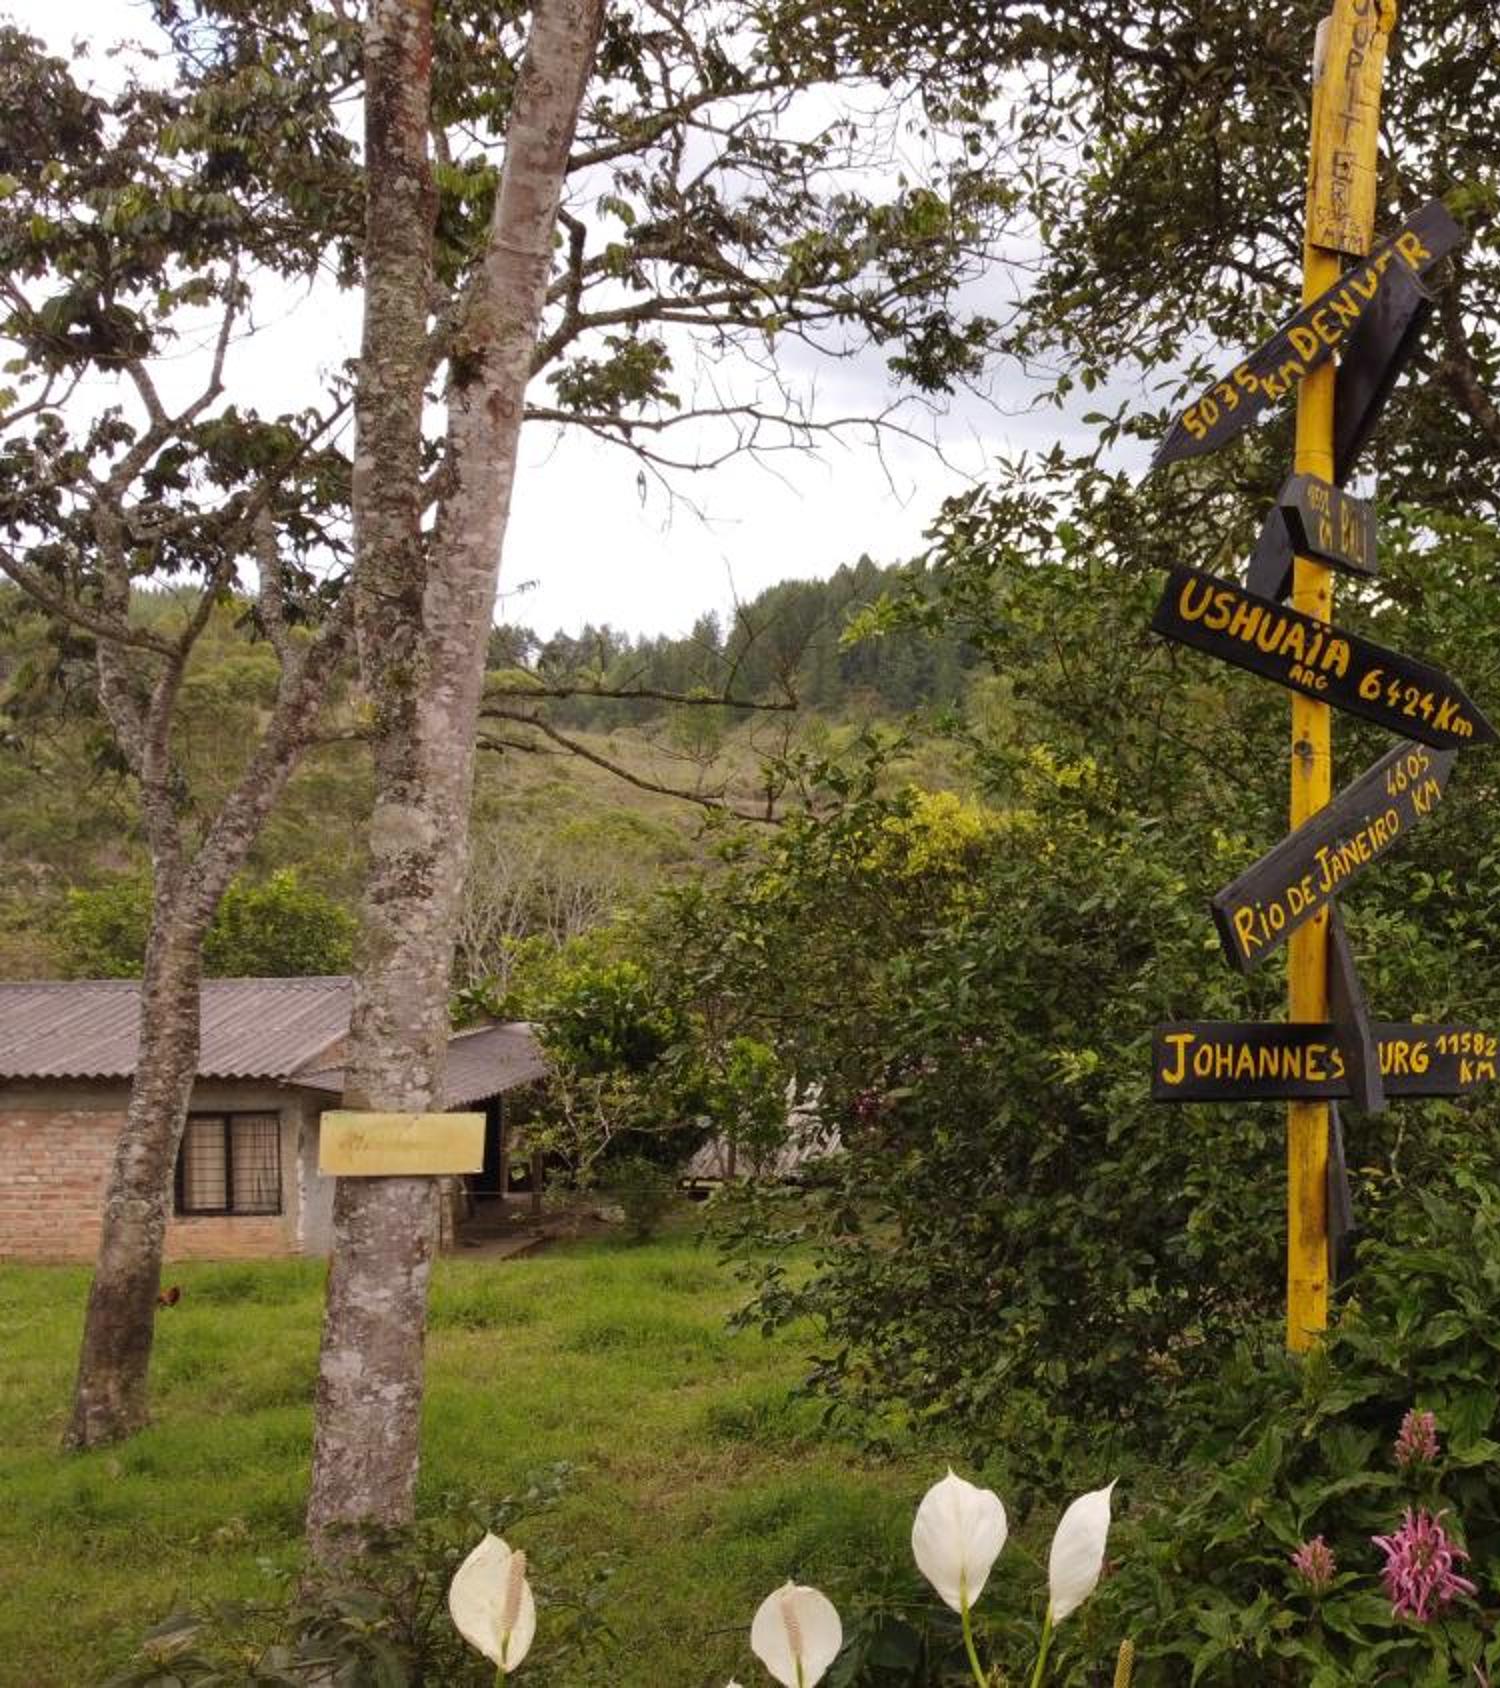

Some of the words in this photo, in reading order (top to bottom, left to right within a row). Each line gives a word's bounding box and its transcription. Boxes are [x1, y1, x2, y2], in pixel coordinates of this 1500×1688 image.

[1183, 364, 1259, 440] 5035
[1289, 664, 1329, 690] ARG
[1387, 743, 1430, 797] 4605
[1411, 776, 1442, 816] KM
[1287, 876, 1317, 916] DE
[1162, 1033, 1429, 1085] JOHANNESURG
[1435, 1031, 1497, 1055] 11582
[1459, 1058, 1497, 1084] KM
